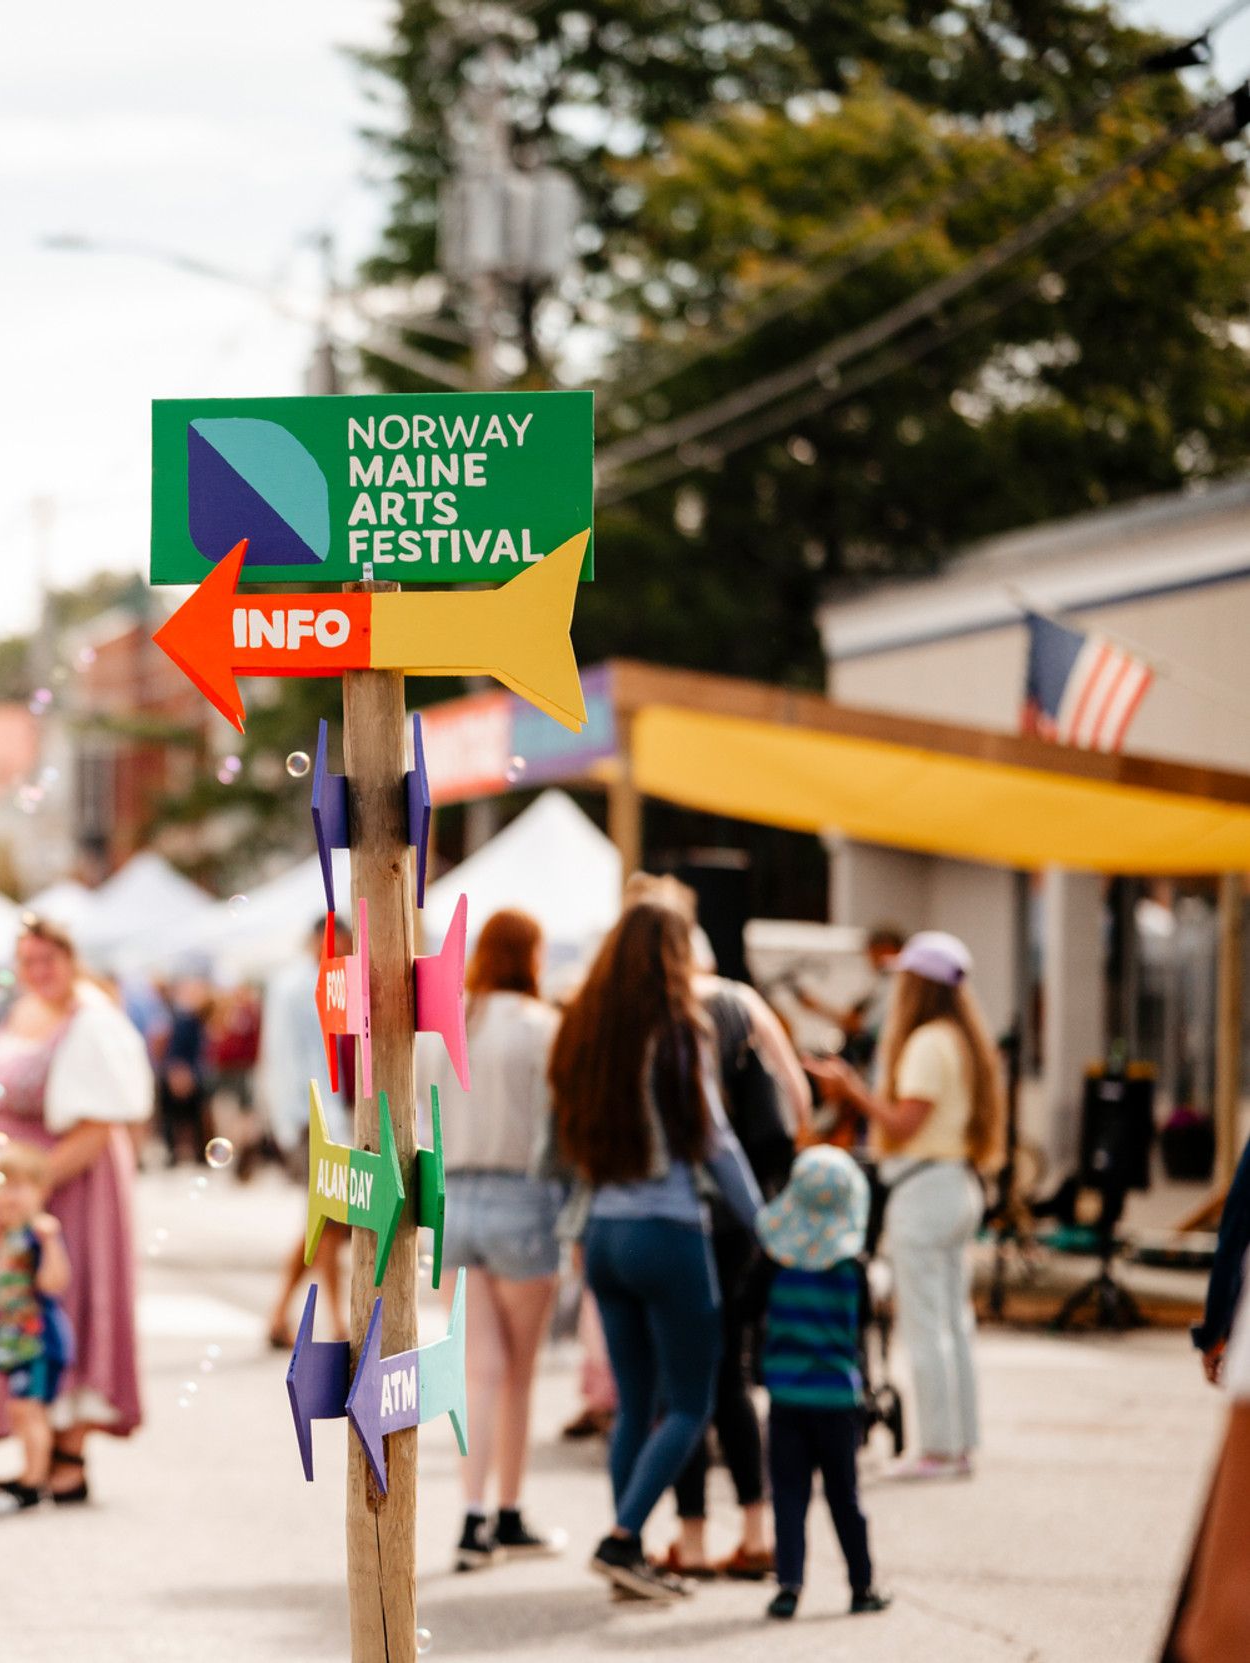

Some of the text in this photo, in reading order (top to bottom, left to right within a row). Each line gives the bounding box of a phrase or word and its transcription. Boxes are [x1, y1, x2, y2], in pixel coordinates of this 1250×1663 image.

[348, 413, 533, 449] NORWAY
[349, 453, 487, 487] MAINE
[348, 492, 458, 525] ARTS
[349, 529, 545, 563] FESTIVAL
[232, 608, 350, 649] INFO
[326, 969, 346, 1011] FOOD
[317, 1158, 374, 1210] ALAN DAY
[380, 1365, 417, 1416] ATM
